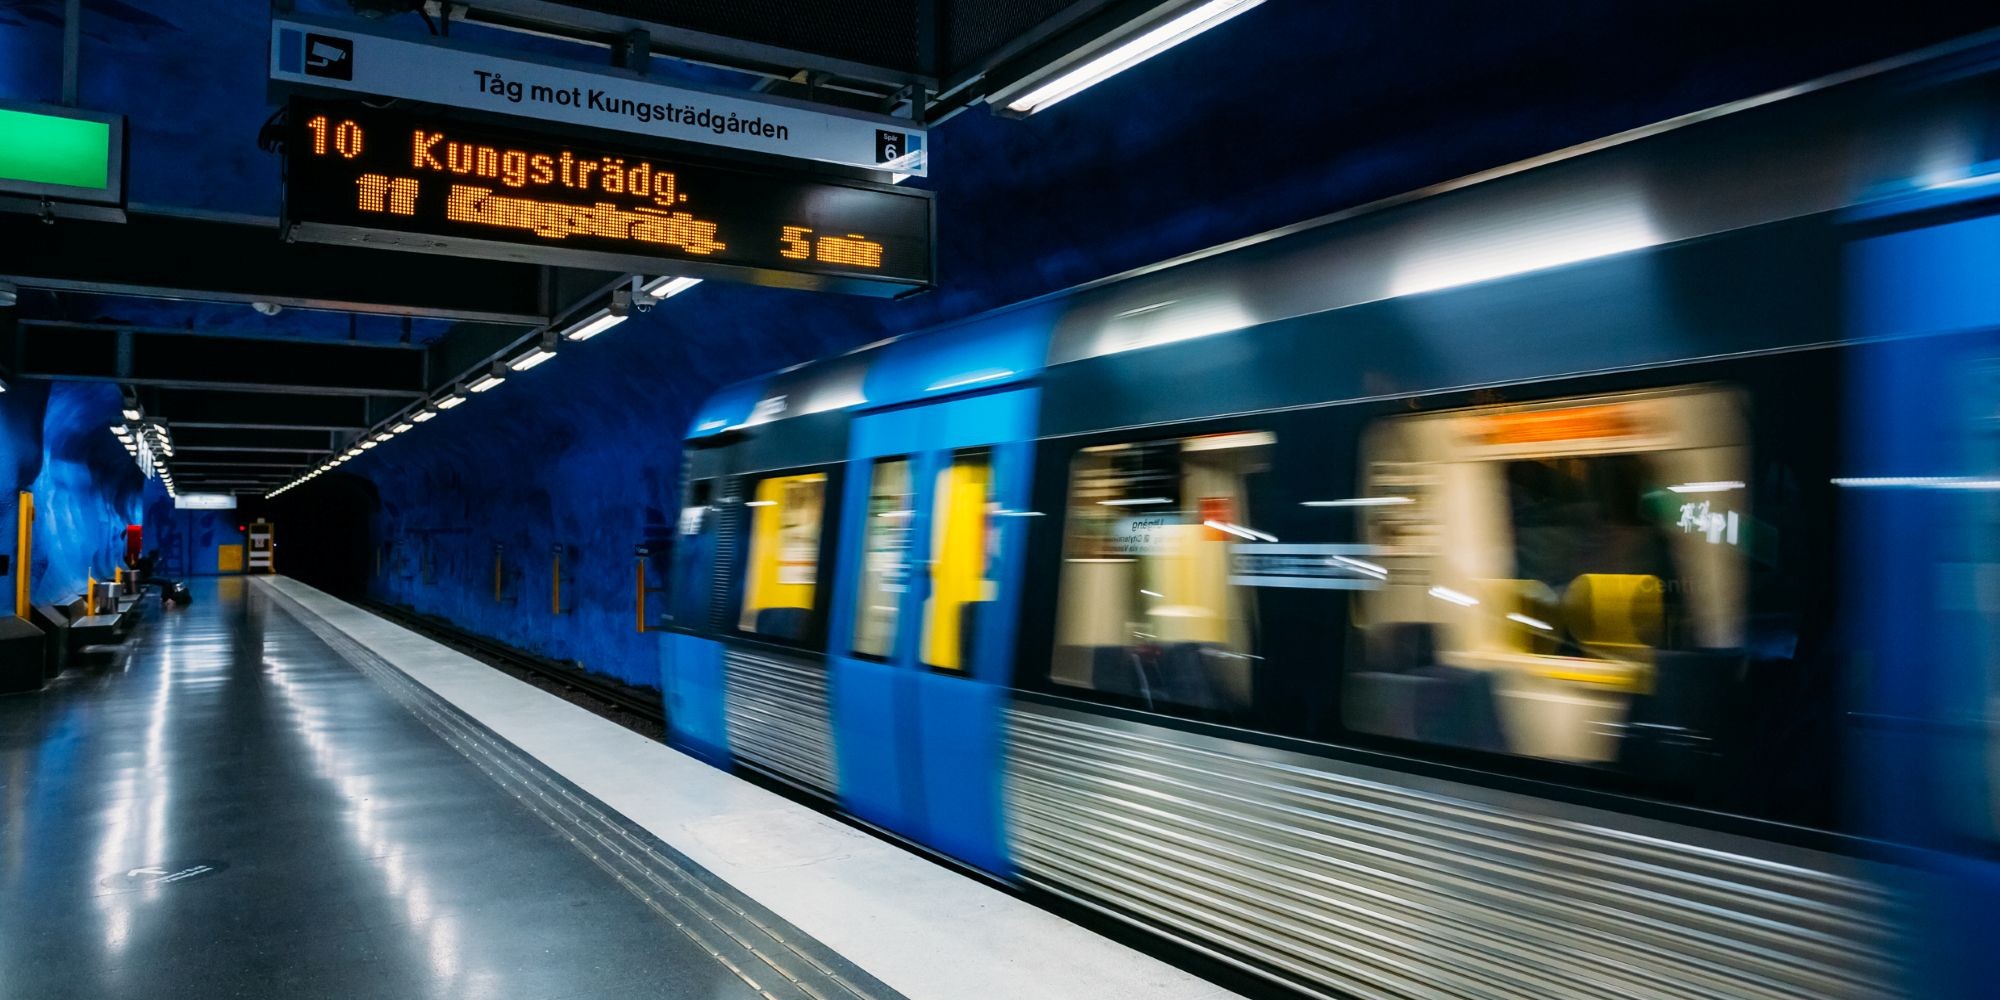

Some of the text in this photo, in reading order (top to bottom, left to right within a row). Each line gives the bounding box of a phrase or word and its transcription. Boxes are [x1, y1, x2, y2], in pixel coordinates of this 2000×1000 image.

[473, 70, 789, 141] Tåg mot Kungsträdgården
[307, 116, 688, 206] 10 Kungsträdg.
[885, 144, 897, 162] 6
